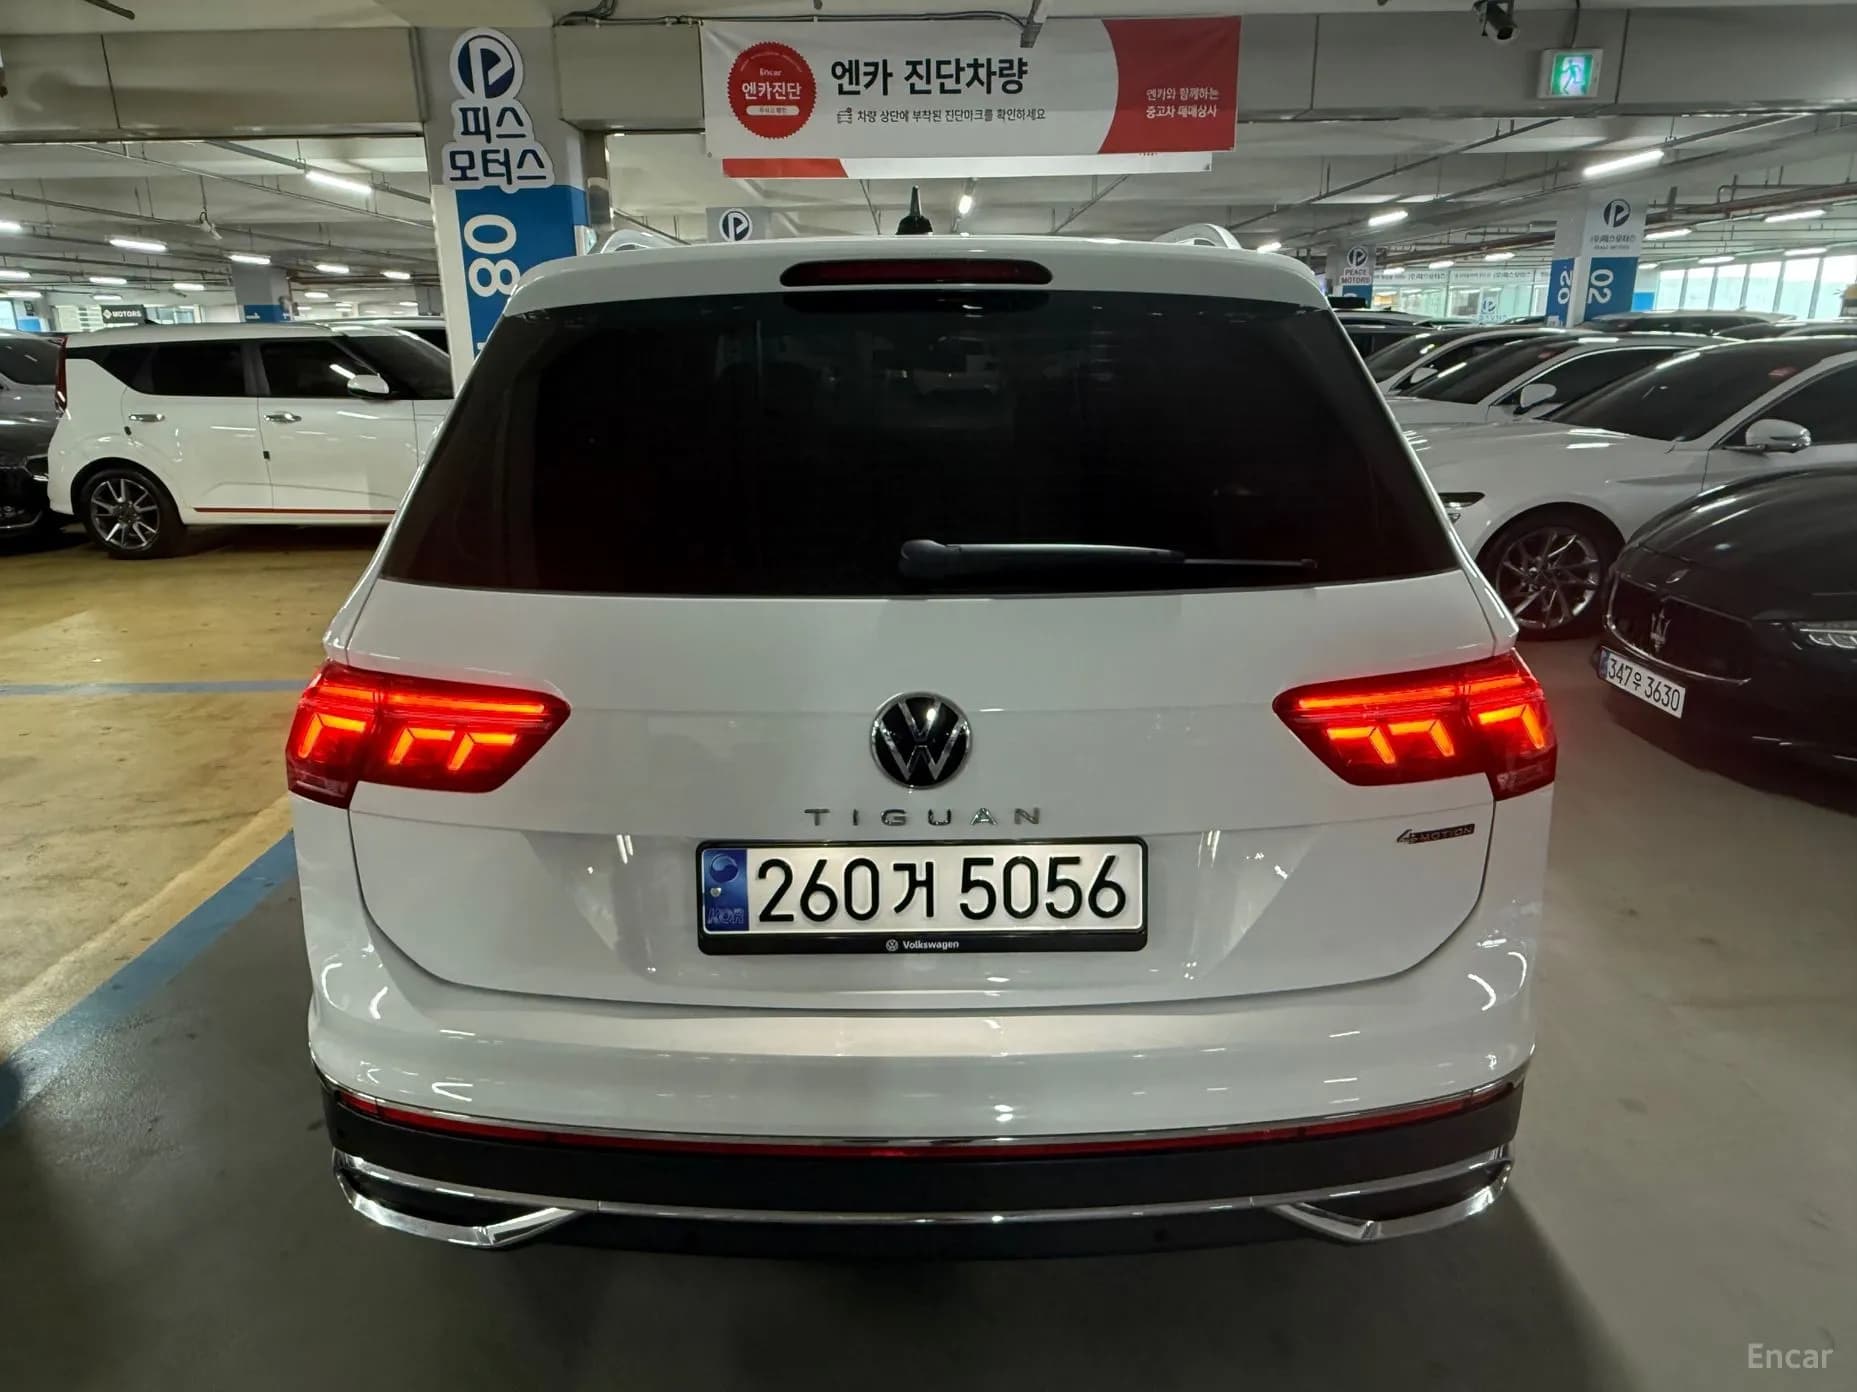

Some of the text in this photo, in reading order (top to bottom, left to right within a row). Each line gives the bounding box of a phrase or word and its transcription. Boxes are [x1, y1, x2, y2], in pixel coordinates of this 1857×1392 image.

[831, 57, 1028, 96] 엔카 진단차량
[741, 81, 802, 100] 엔카진단
[1146, 87, 1219, 101] 엔카와 함께하는
[857, 108, 1046, 123] 차량 상단에 부착된 진단마크를 확인하세요
[1146, 104, 1217, 119] 중고차 매매상사
[459, 105, 527, 144] 피스
[449, 147, 547, 185] 모터스
[463, 214, 521, 297] 08
[1587, 269, 1614, 304] 02
[112, 310, 142, 318] MOTORS
[1608, 658, 1681, 712] 347우 3630
[804, 807, 1042, 827] TIGUAN
[757, 854, 1127, 923] 260거 5056
[706, 905, 745, 925] KOR
[902, 940, 960, 951] Volkswagen
